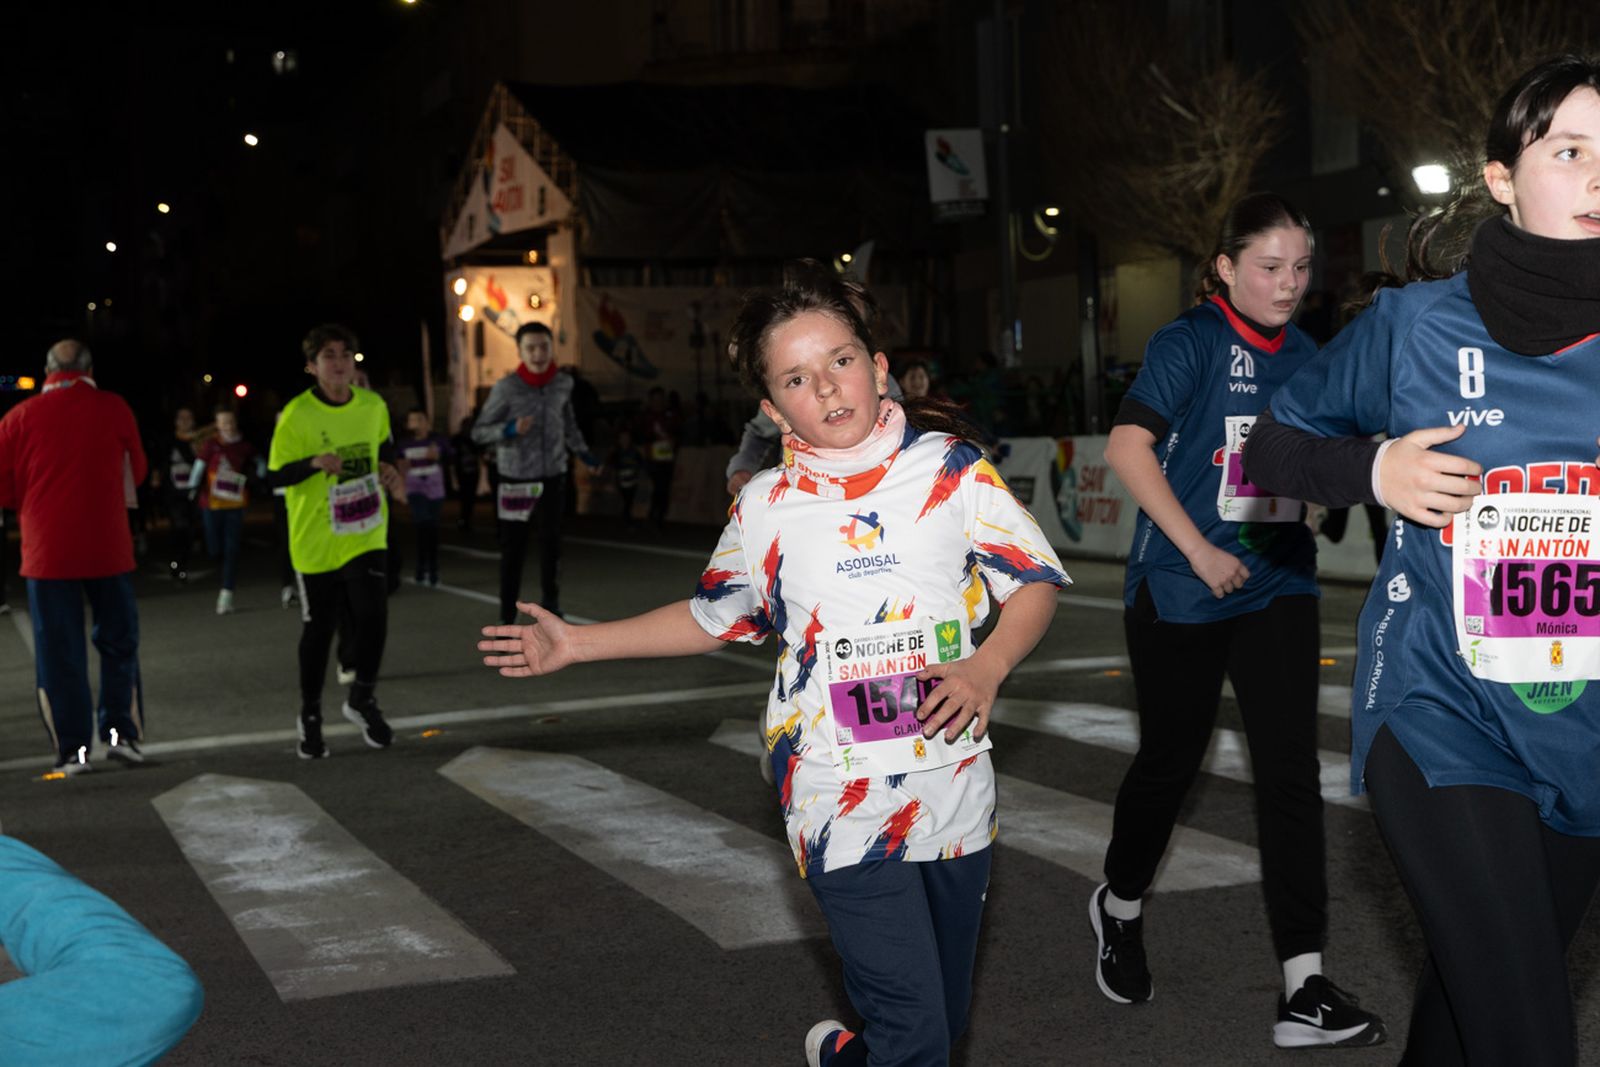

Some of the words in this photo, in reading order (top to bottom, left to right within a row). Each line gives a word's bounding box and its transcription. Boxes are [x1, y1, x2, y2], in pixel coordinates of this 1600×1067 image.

[1458, 346, 1486, 399] 8
[1229, 381, 1258, 394] vive
[1447, 406, 1505, 427] vive
[1480, 510, 1499, 525] 43
[1503, 515, 1565, 533] NOCHE
[1568, 516, 1592, 533] DE
[1522, 534, 1590, 558] ANTÓN
[836, 553, 901, 574] ASODISAL
[848, 571, 863, 579] club
[1374, 608, 1395, 647] PABLO
[1536, 621, 1578, 634] Mónica
[836, 642, 851, 655] 43
[856, 638, 905, 658] NOCHE
[908, 635, 925, 650] DE
[839, 661, 872, 681] SAN
[875, 651, 927, 677] ANTÓN
[1365, 650, 1384, 711] CARVAJAL
[847, 674, 941, 726] 154
